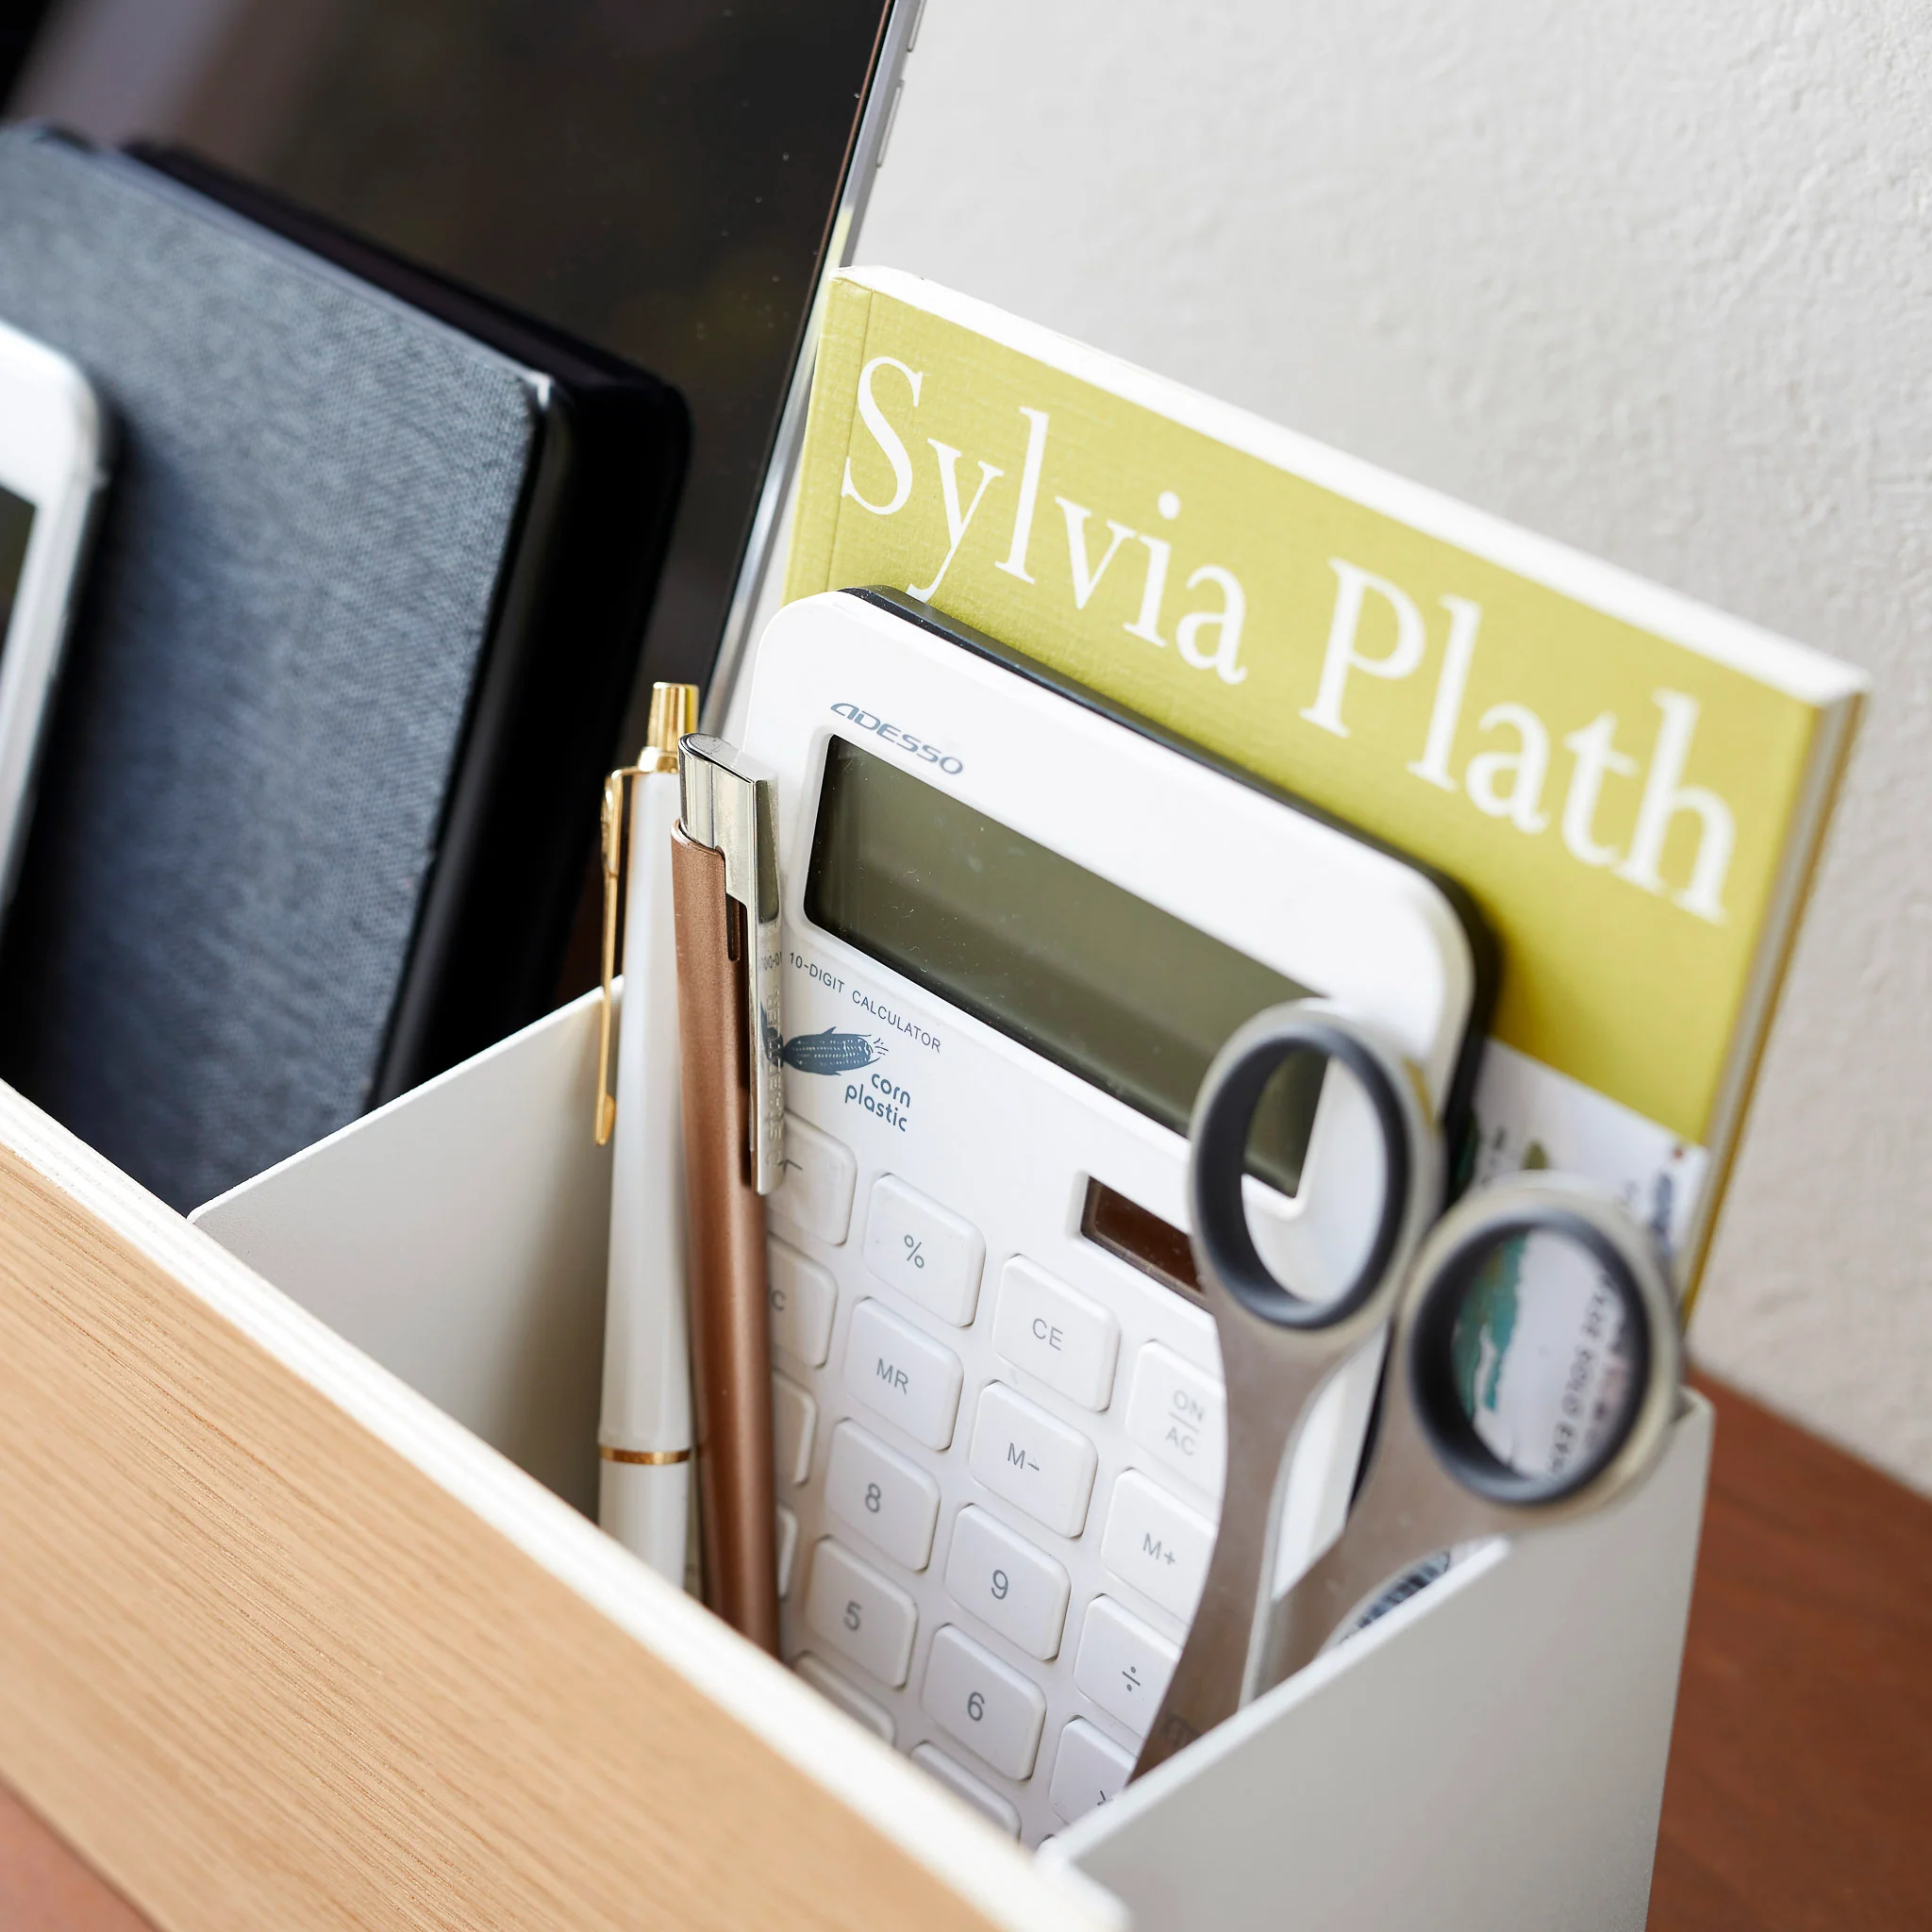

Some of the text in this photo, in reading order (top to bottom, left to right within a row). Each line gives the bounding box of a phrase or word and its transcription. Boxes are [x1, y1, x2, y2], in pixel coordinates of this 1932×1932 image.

[841, 356, 1738, 926] Sylvia Plath
[830, 702, 964, 775] ADESSO
[789, 952, 845, 993] 10-DIGIT
[852, 991, 941, 1053] CALCULATOR
[871, 1073, 911, 1108] corn
[844, 1084, 908, 1132] plastic
[904, 1234, 925, 1269] %
[1032, 1318, 1063, 1351] CE
[876, 1358, 908, 1394] MR
[1173, 1390, 1206, 1423] ON
[1165, 1426, 1196, 1457] AC
[865, 1483, 882, 1513] 8
[1143, 1533, 1176, 1565] M+
[991, 1570, 1009, 1600] 9
[844, 1602, 861, 1632] 5
[967, 1691, 985, 1722] 6
